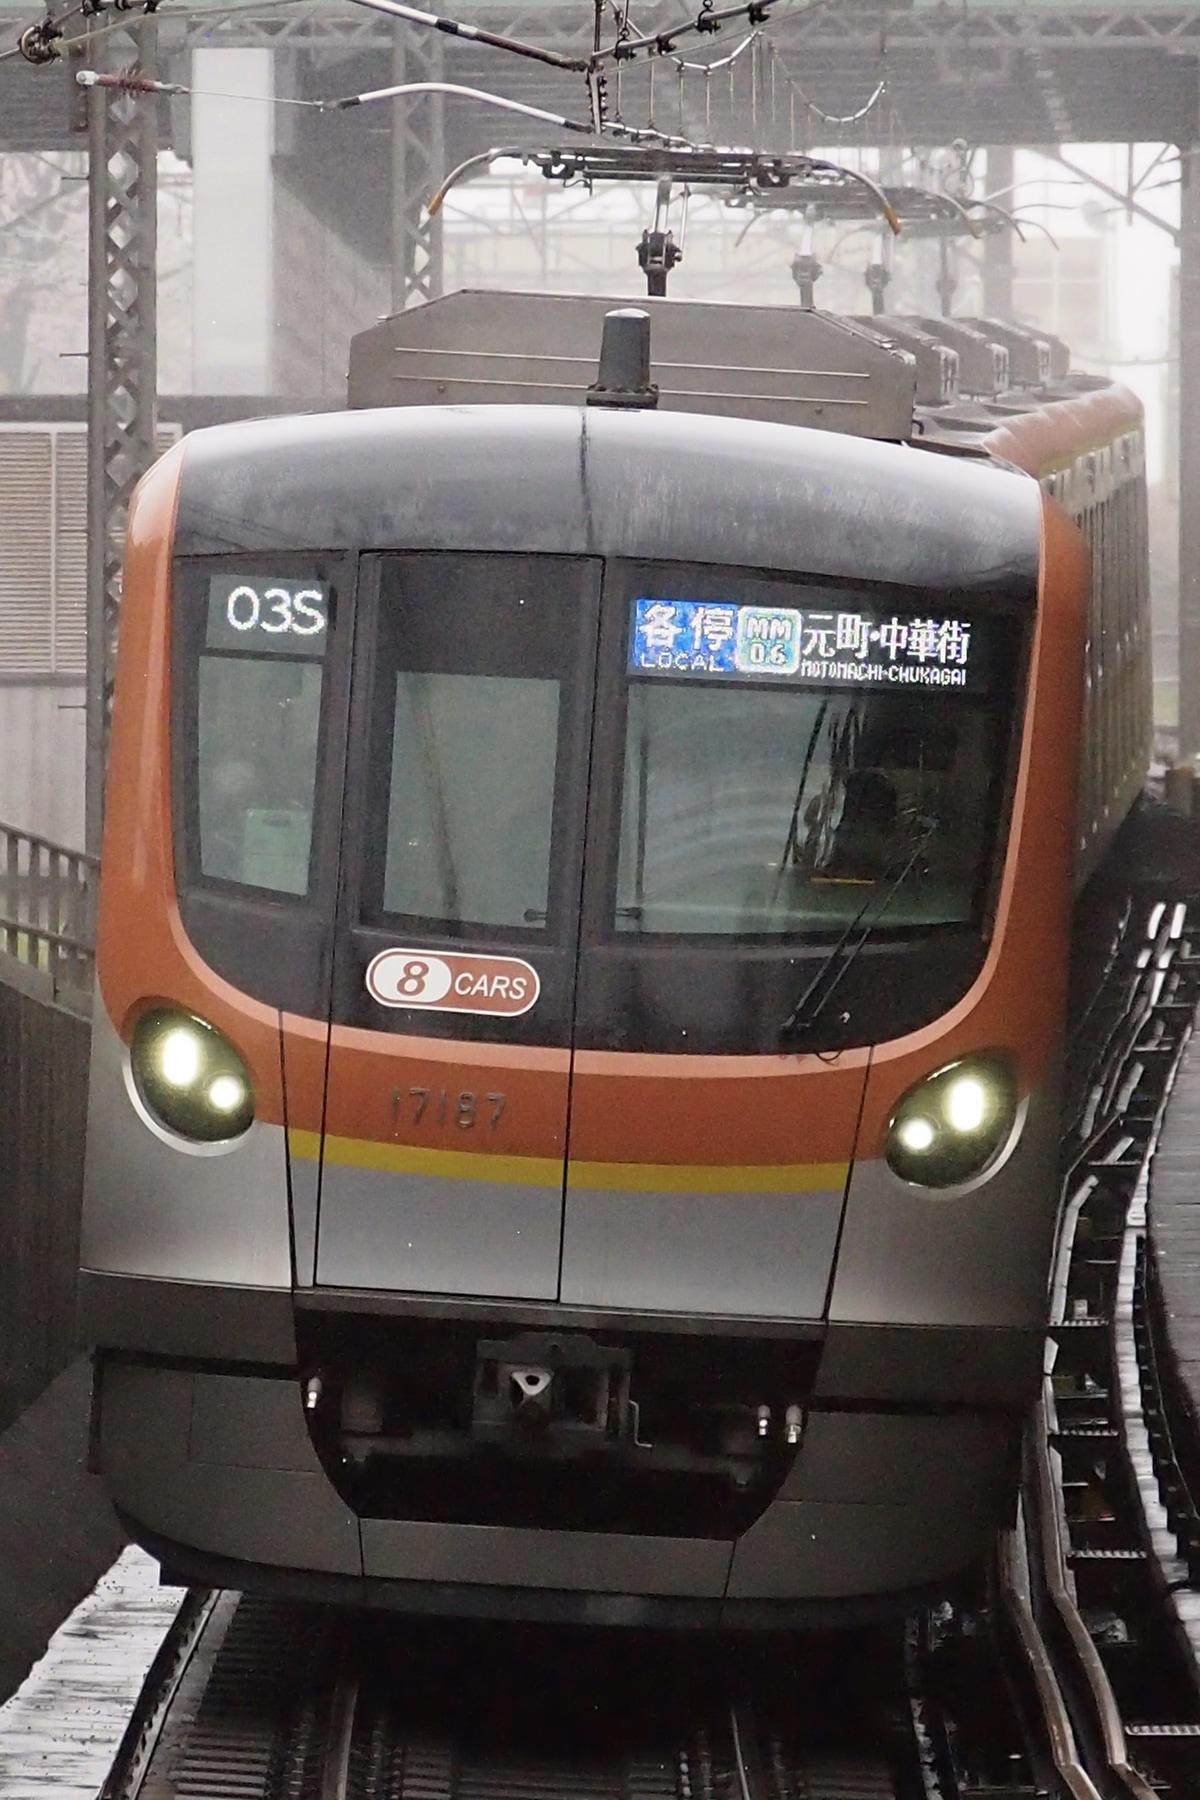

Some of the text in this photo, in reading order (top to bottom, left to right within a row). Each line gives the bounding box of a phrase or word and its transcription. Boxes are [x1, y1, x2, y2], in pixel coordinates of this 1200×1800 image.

[227, 586, 326, 635] 03S
[638, 603, 734, 651] 各停
[746, 616, 792, 641] MM
[641, 651, 725, 673] LOCAL
[749, 643, 787, 665] 06
[396, 960, 528, 1000] 8 CARS
[390, 1085, 506, 1130] 17187
